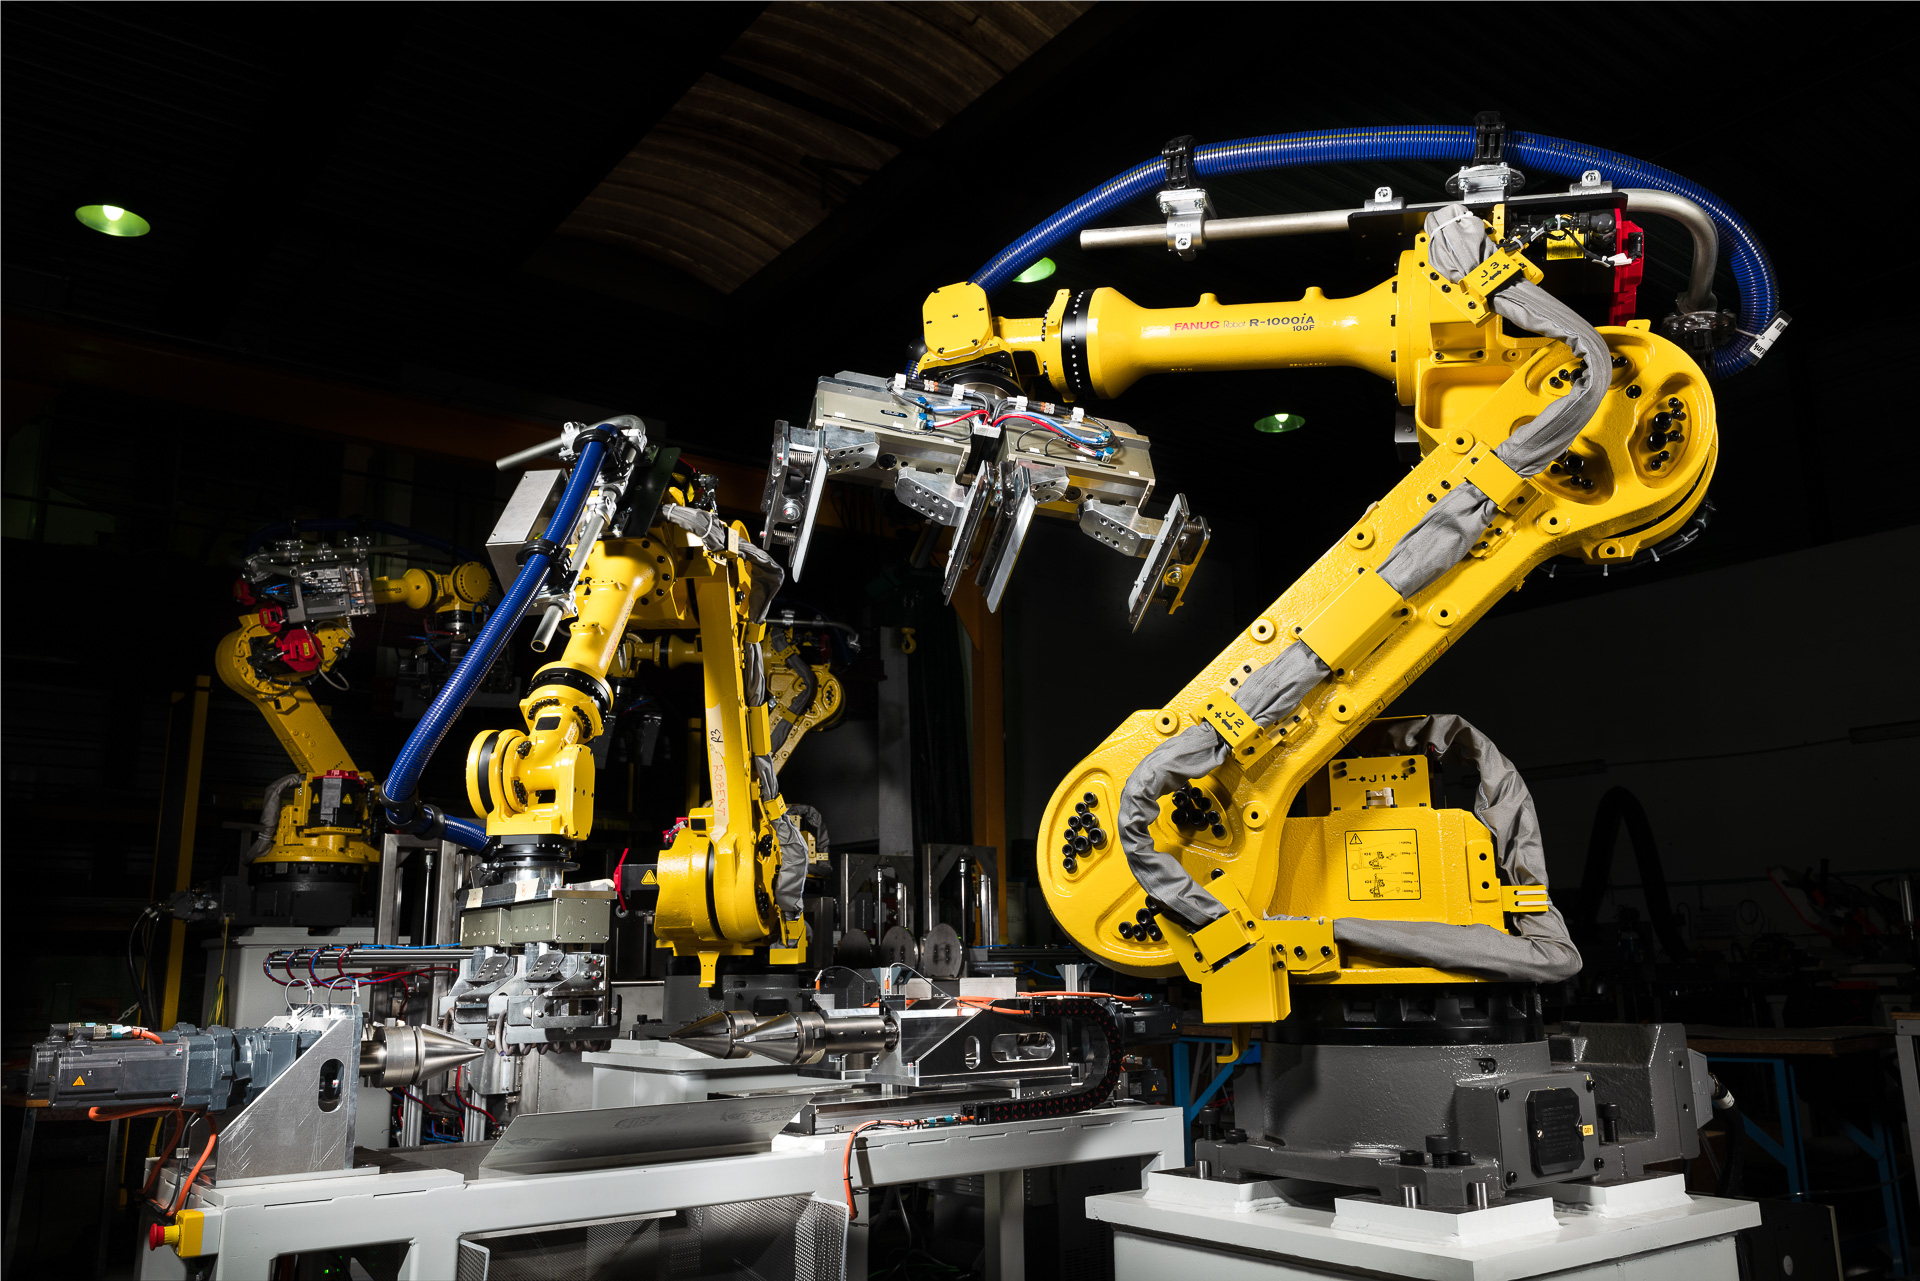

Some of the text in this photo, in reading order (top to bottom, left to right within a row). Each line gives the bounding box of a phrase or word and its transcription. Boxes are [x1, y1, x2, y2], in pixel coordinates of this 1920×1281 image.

[1174, 313, 1315, 331] FANUC Robot R-1000iA
[1292, 324, 1315, 332] 100F
[712, 764, 726, 817] ROBERT
